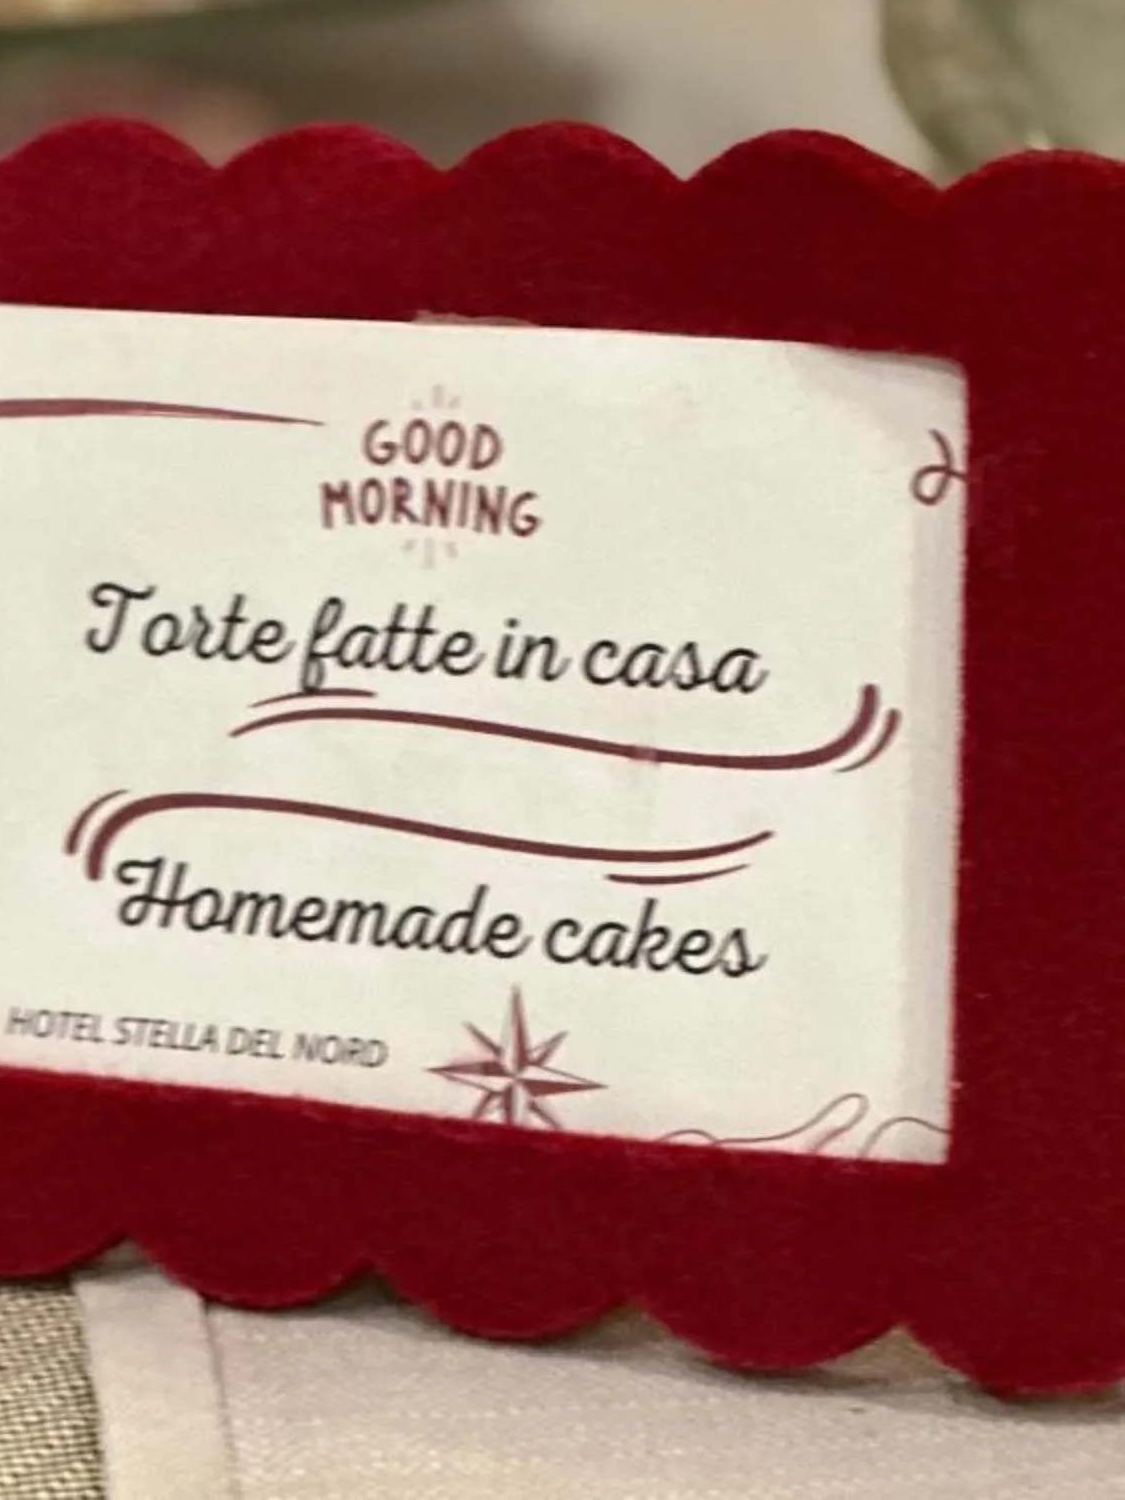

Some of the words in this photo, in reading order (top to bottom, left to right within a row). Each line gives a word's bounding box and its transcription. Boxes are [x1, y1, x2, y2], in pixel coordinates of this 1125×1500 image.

[363, 418, 502, 470] GOOD
[321, 478, 542, 537] MORNING
[86, 582, 294, 664] Torte
[301, 597, 484, 693] fatte
[493, 618, 571, 682] in
[582, 640, 770, 694] casa
[115, 856, 531, 959] Homemade
[544, 898, 768, 979] cakes
[7, 1006, 105, 1045] HOTEL
[112, 1016, 219, 1055] STELLA
[226, 1026, 283, 1060] DEL
[292, 1032, 388, 1068] NORD
